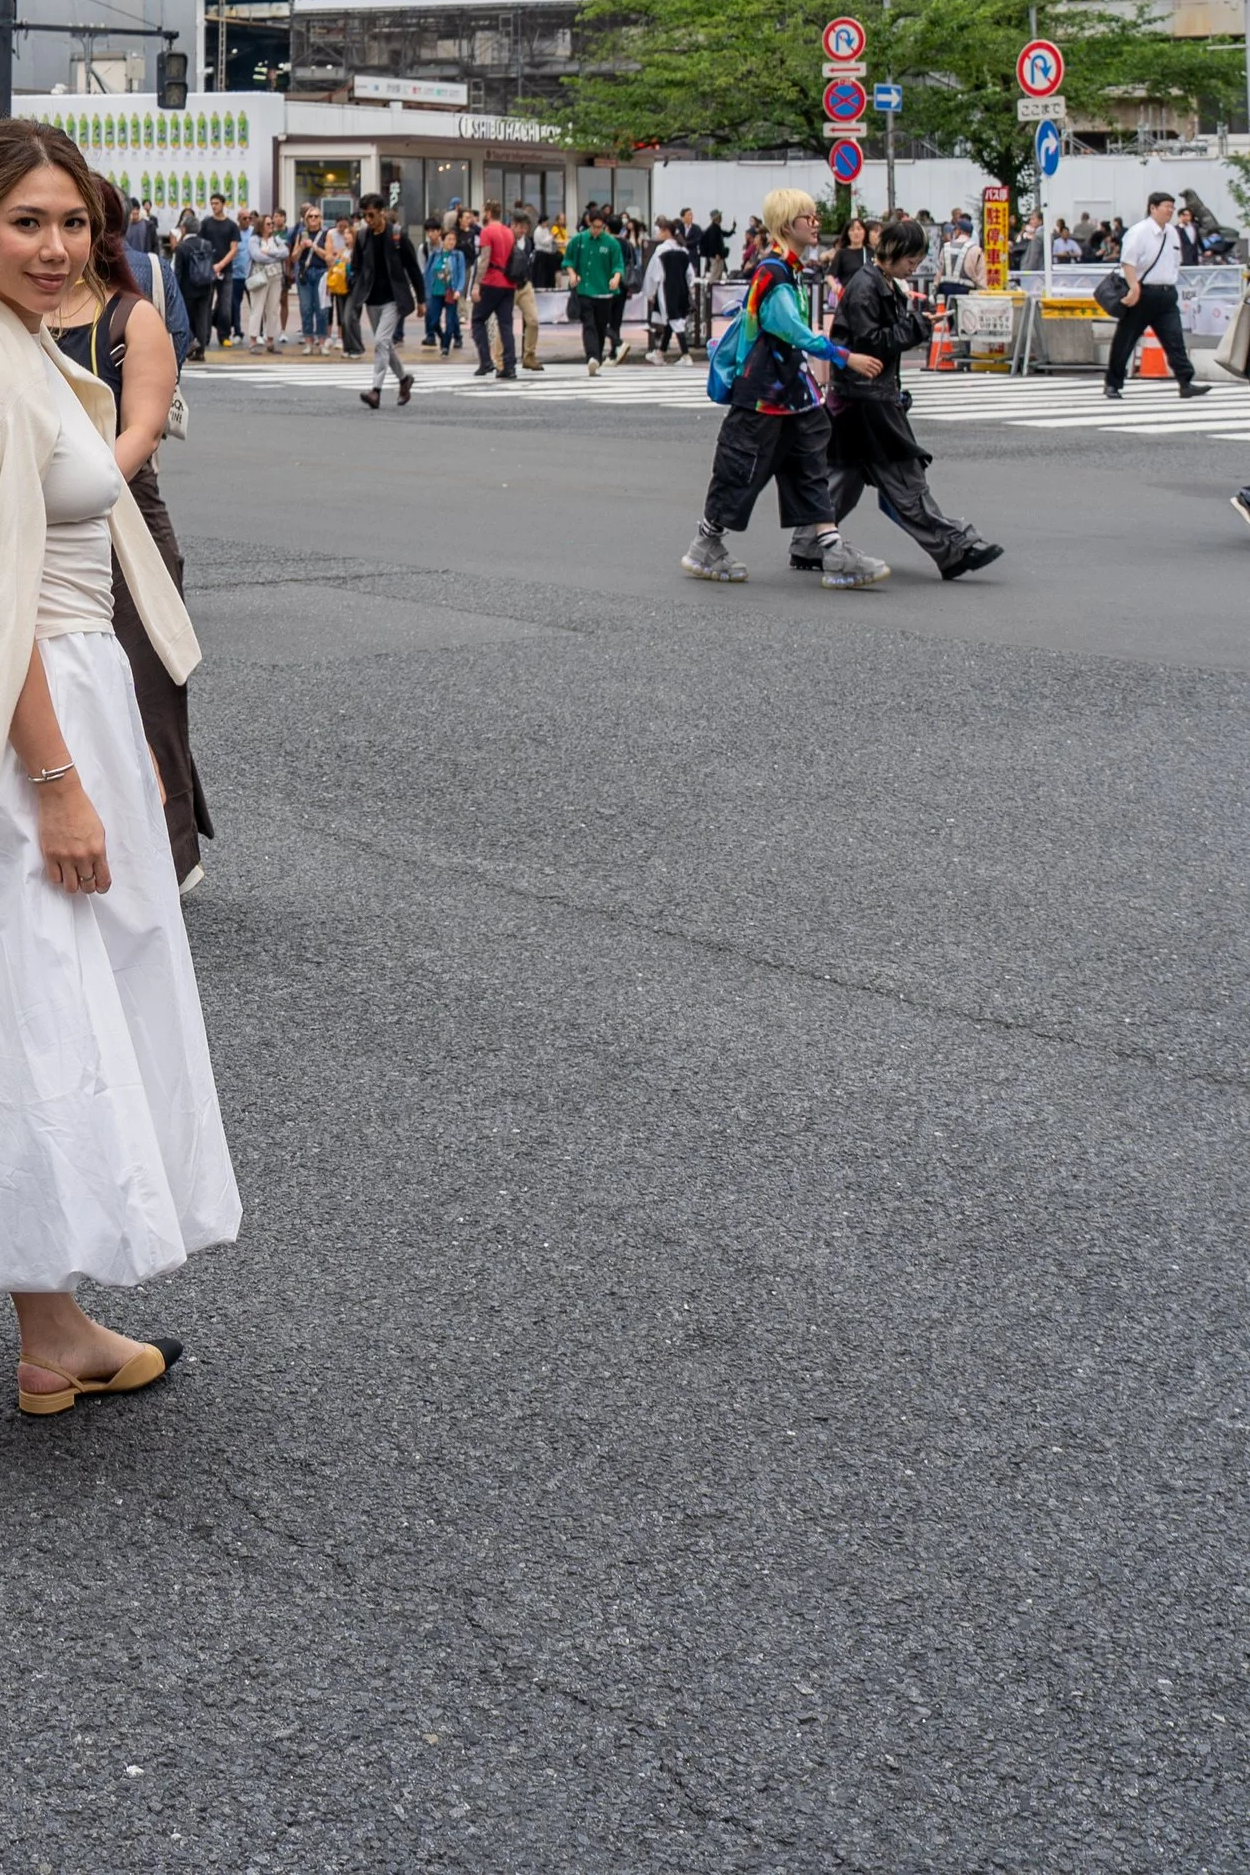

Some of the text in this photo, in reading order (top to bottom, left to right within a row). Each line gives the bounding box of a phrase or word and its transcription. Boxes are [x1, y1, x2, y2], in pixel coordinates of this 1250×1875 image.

[1021, 102, 1062, 117] ここまで
[984, 187, 1009, 201] バス停
